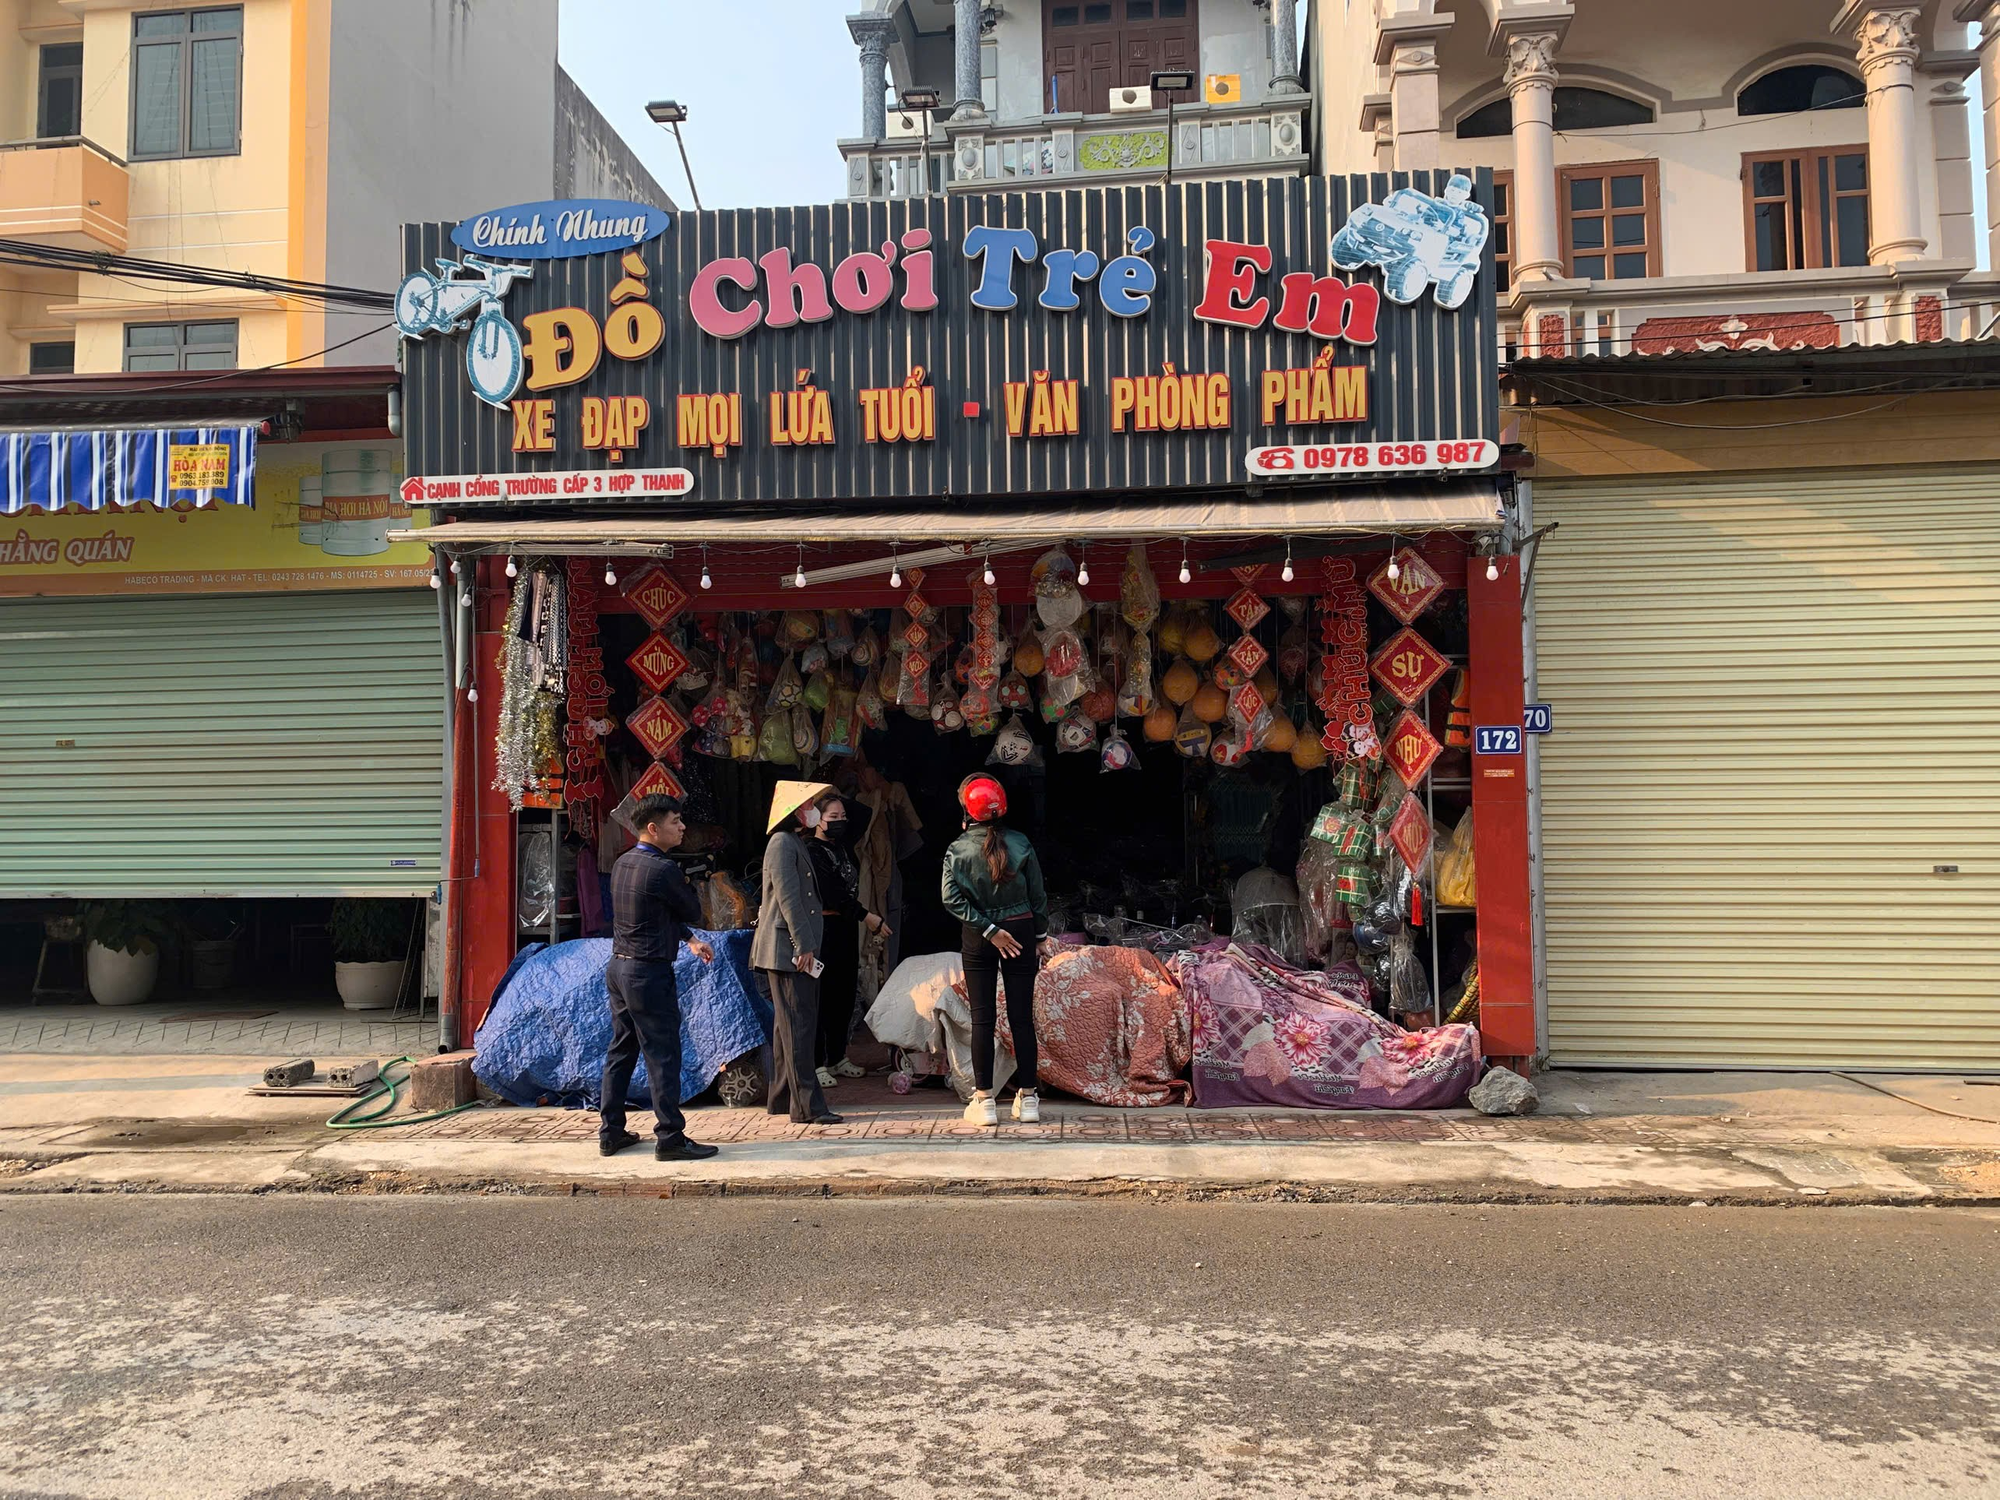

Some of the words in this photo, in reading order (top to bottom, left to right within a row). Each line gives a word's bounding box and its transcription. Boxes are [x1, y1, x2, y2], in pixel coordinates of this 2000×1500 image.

[473, 214, 547, 247] Chính
[556, 209, 648, 242] Nhung
[522, 251, 665, 392] Đồ
[689, 228, 939, 340] Chơi
[962, 225, 1157, 318] Trẻ
[1193, 239, 1380, 346] Em
[511, 399, 556, 452] XE
[581, 395, 650, 463] ĐẠP
[677, 392, 743, 458] MỌI
[770, 368, 836, 446] LỨA
[859, 365, 936, 443] TUỔI
[1003, 369, 1080, 438] VĂN
[1111, 362, 1231, 433] PHÒNG
[1262, 345, 1369, 427] PHẨM
[1304, 446, 1369, 469] 0978
[1377, 444, 1427, 466] 636
[1437, 441, 1486, 464] 987
[427, 481, 461, 501] CẠNH
[465, 474, 499, 498] CỔNG
[505, 475, 557, 496] TRƯỜNG
[563, 472, 589, 494] CẤP
[593, 476, 602, 492] 3
[608, 474, 635, 494] HỢP
[642, 474, 685, 491] THANH
[359, 498, 371, 516] HÀ
[373, 497, 388, 517] NỘI
[65, 529, 134, 566] QUÁN
[125, 575, 158, 585] HABECO
[160, 574, 194, 584] TRADING
[231, 573, 246, 582] HAT
[272, 572, 290, 582] 0243
[292, 571, 305, 581] 728
[307, 571, 324, 581] 1476
[331, 571, 345, 580] MS:
[384, 569, 397, 579] SV:
[642, 582, 676, 612] CHÚC
[643, 646, 675, 676] MỪNG
[1392, 651, 1424, 683] SỰ
[646, 710, 672, 743] NĂM
[1481, 730, 1517, 750] 172
